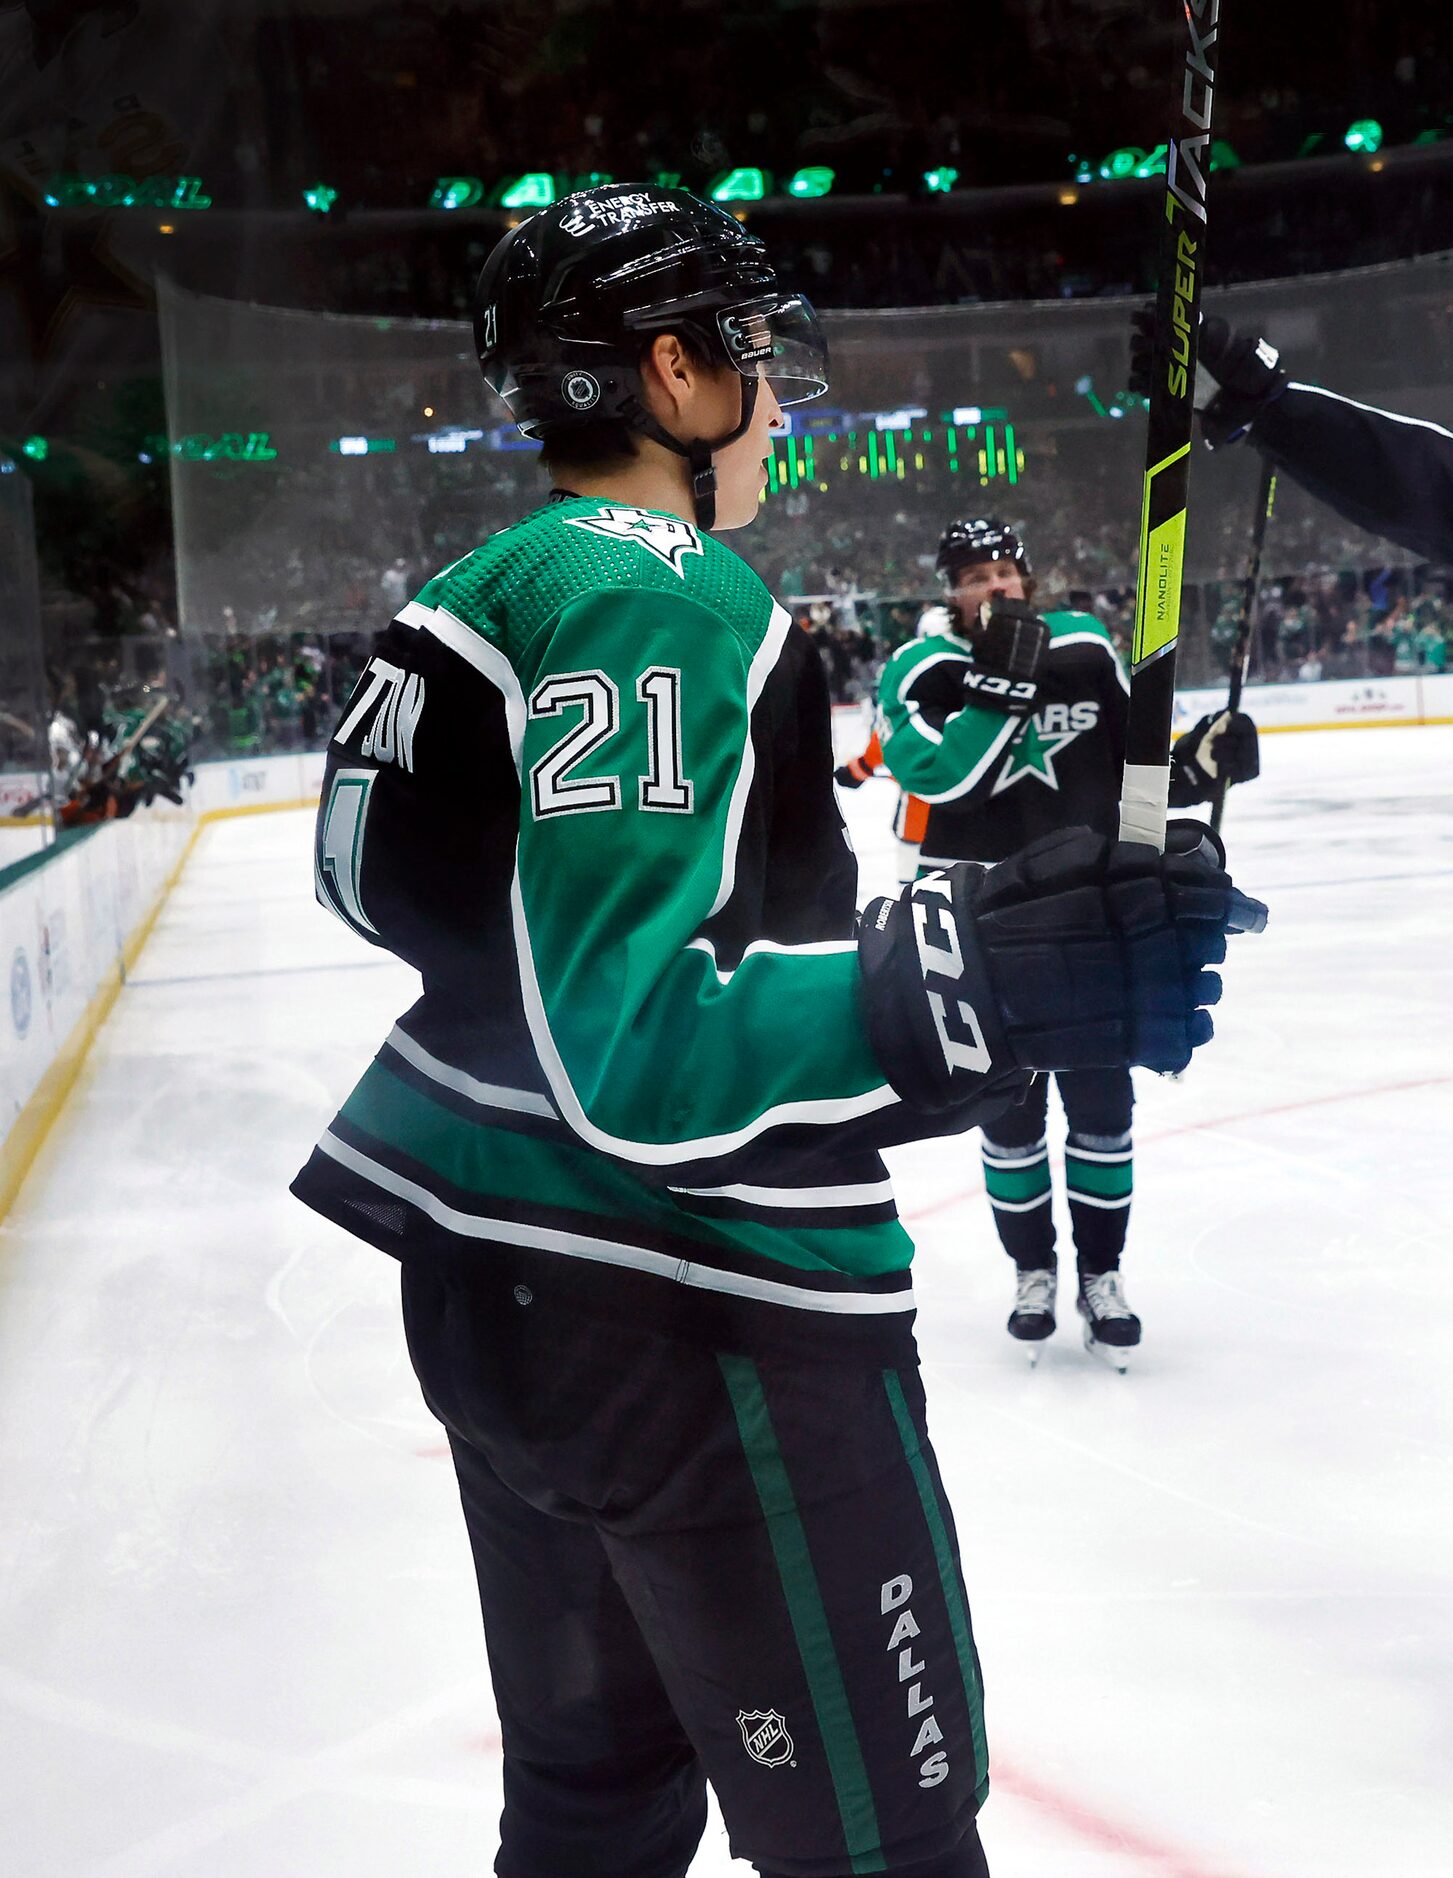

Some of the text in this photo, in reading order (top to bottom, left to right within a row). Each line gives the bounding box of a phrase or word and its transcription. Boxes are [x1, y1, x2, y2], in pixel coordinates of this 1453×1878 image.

[589, 192, 651, 216] ENERGY
[599, 201, 680, 227] TRANSFER
[741, 347, 772, 360] BAUER
[1168, 230, 1197, 399] SUPER
[1157, 543, 1170, 621] NANOLITE
[334, 656, 425, 774] TSON
[528, 666, 694, 822] 21
[881, 1574, 949, 1788] DALLAS
[753, 1723, 779, 1754] NHL
